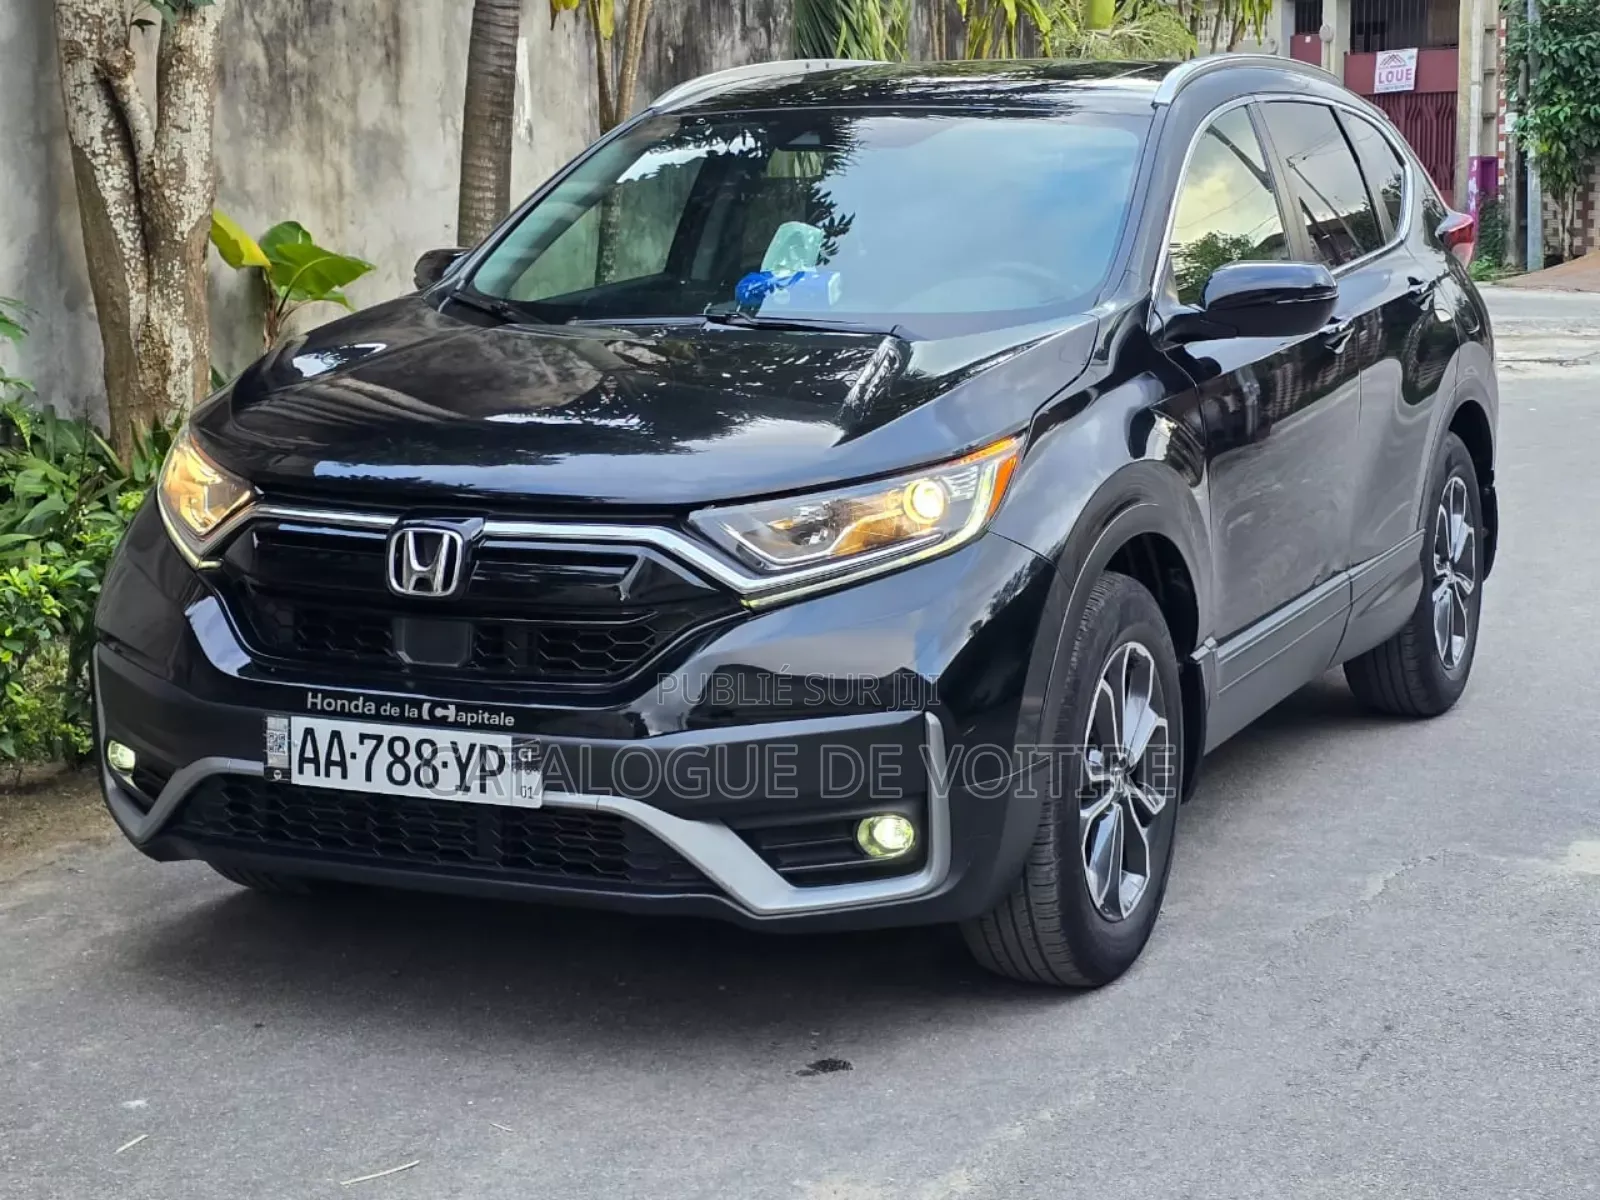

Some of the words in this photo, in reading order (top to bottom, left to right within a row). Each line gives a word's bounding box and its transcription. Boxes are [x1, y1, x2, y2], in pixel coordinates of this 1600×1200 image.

[1378, 68, 1412, 84] LOUE
[306, 691, 376, 715] Honda
[380, 702, 400, 717] de
[404, 704, 419, 719] la
[421, 702, 515, 726] Capitale
